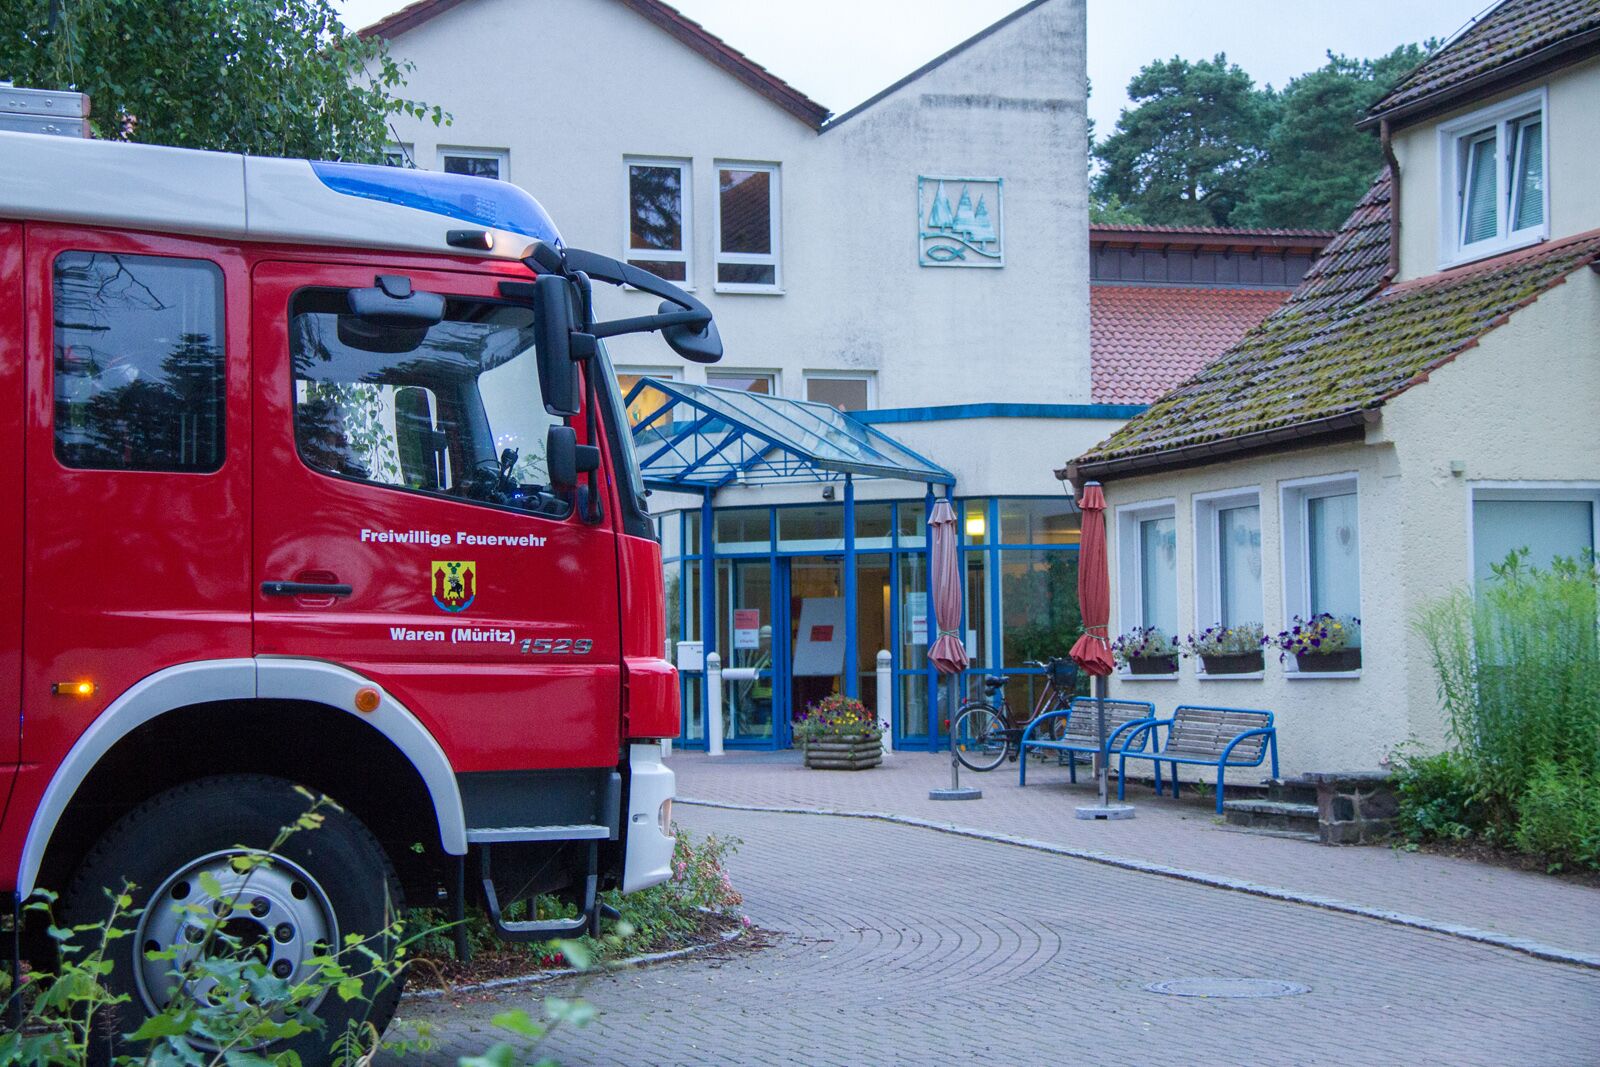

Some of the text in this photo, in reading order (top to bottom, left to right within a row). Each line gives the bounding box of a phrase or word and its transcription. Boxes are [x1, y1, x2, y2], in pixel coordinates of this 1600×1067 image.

[360, 528, 547, 547] Freiwillige Feuerwehr
[389, 627, 516, 644] Waren (Müritz)
[519, 638, 593, 654] 1529
